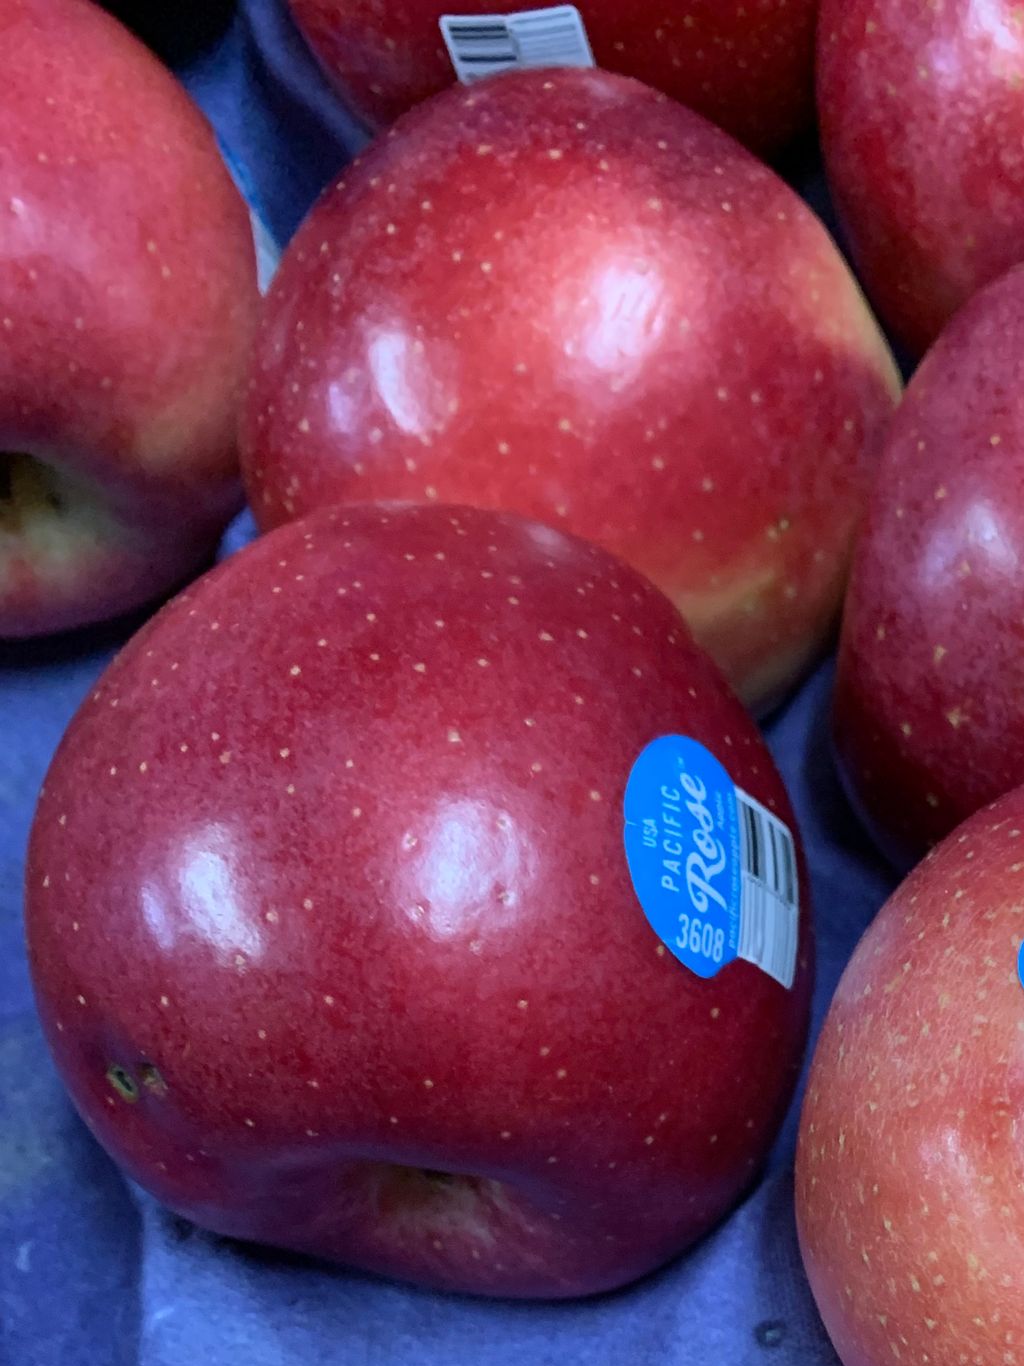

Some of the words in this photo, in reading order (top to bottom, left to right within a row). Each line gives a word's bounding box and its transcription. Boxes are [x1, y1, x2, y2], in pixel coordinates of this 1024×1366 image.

[643, 818, 659, 848] USA
[662, 785, 681, 892] PACIFIC
[680, 772, 727, 912] Rose
[676, 913, 725, 963] 3608
